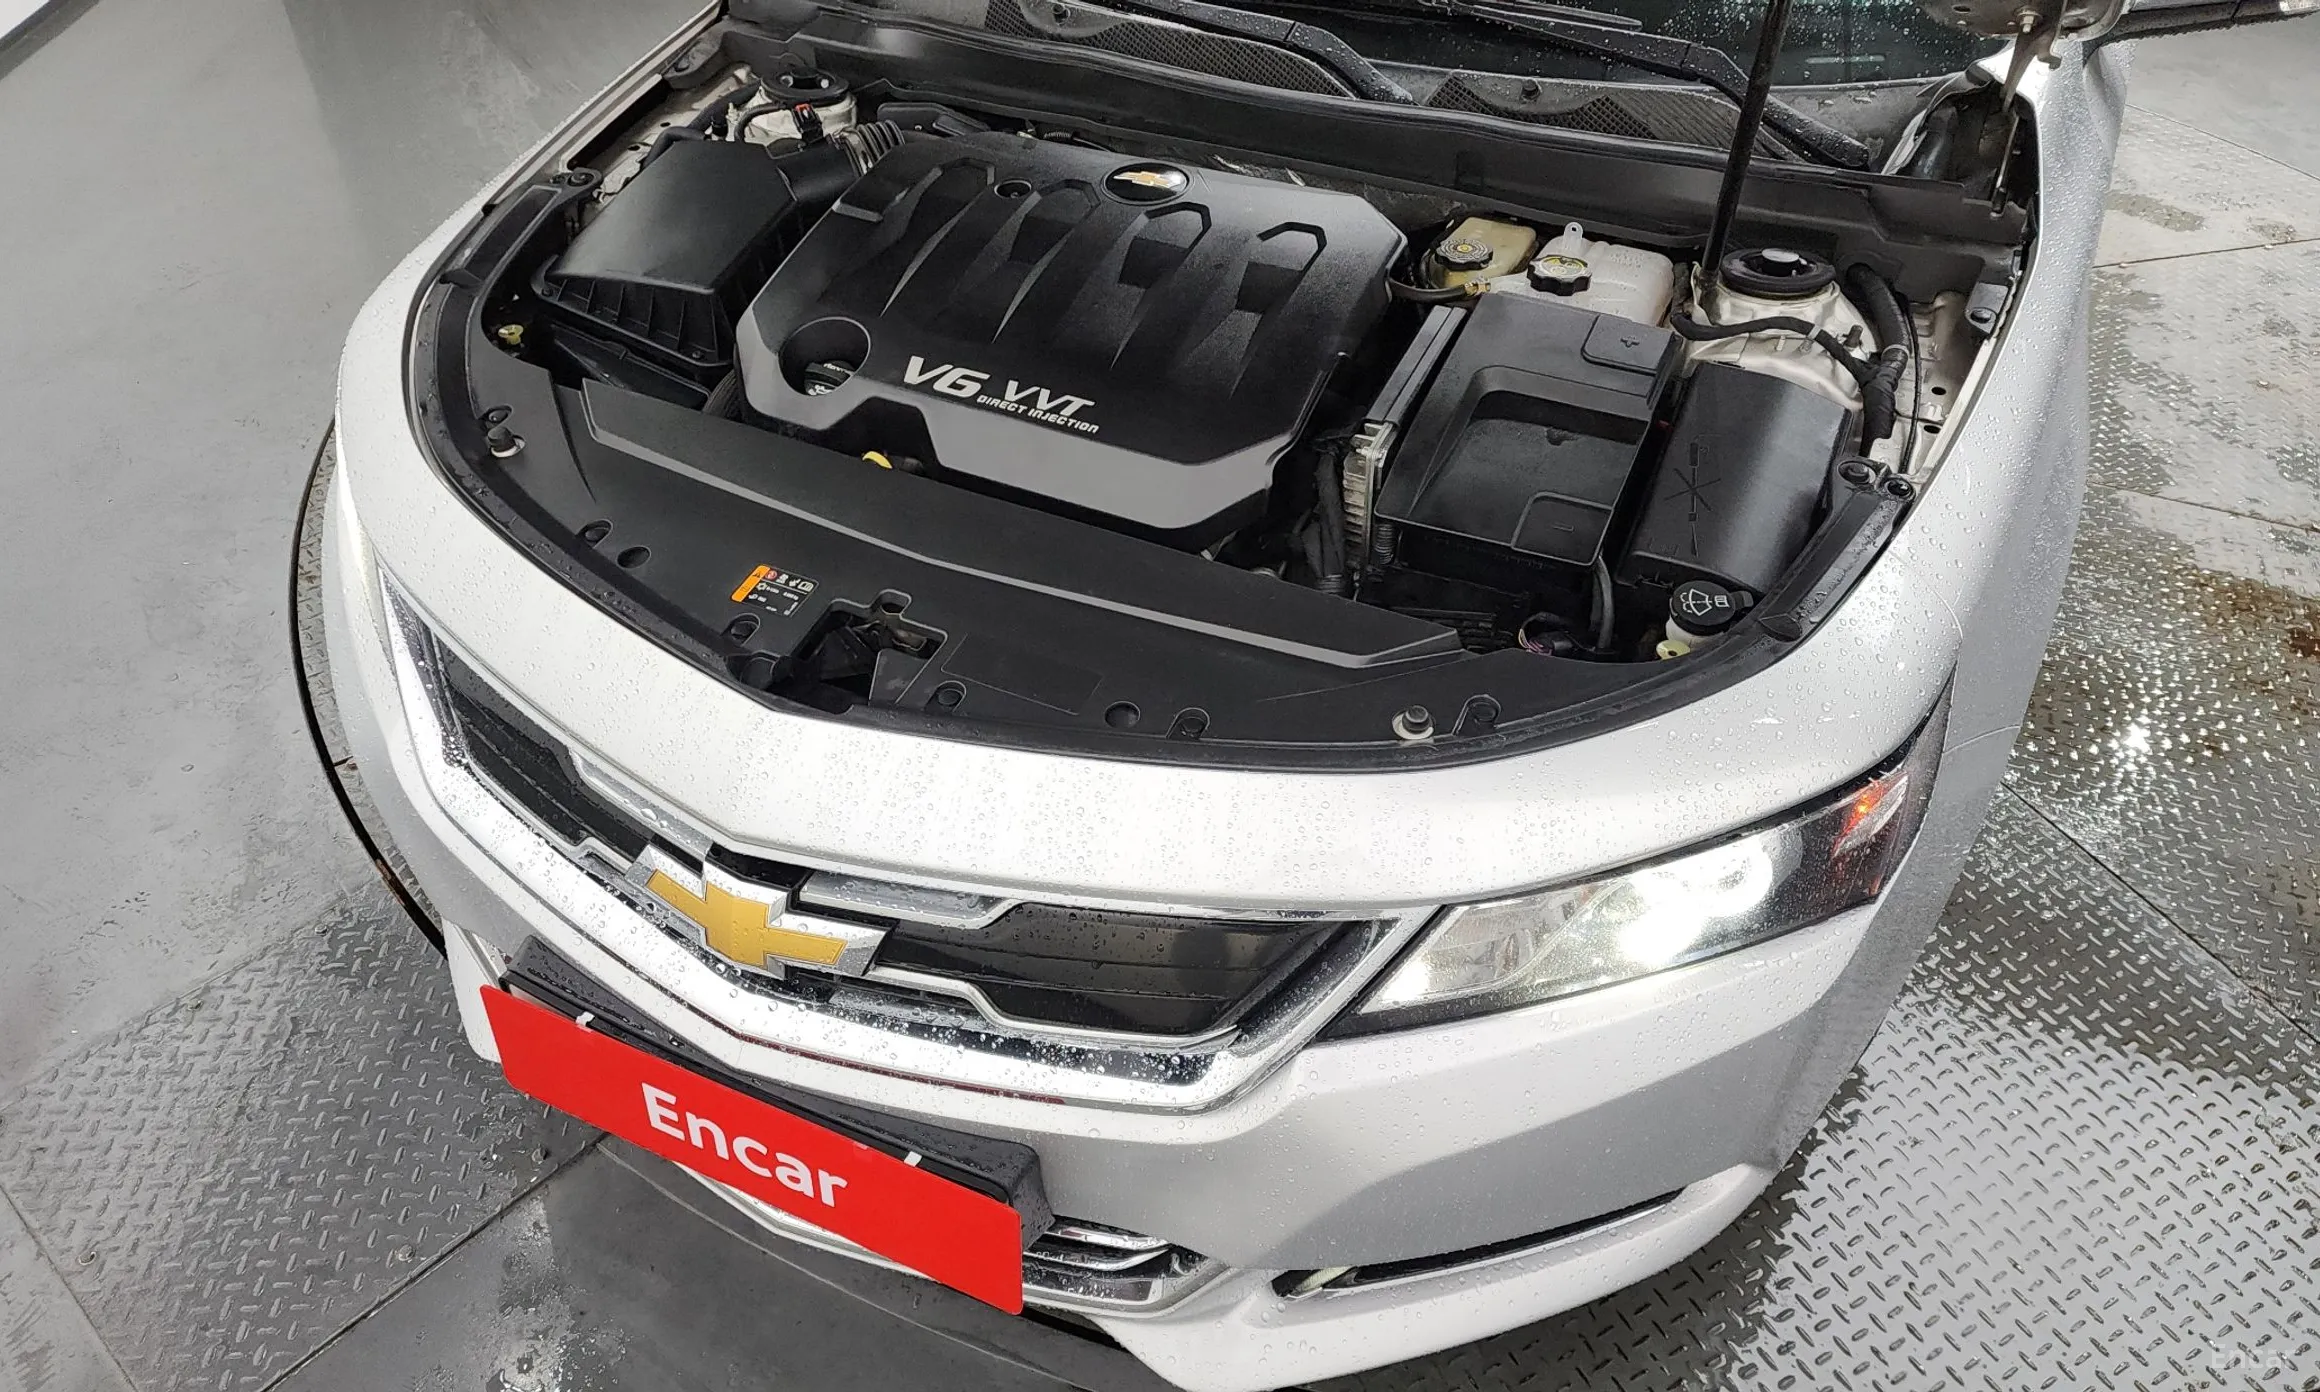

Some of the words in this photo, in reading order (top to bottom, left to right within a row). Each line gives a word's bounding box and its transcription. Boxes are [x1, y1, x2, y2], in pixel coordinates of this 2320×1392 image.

[903, 355, 991, 398] V6
[1004, 379, 1096, 418] VVT
[976, 394, 1029, 414] DIRECT
[1027, 408, 1100, 434] INJECTION
[641, 1082, 848, 1208] Encar
